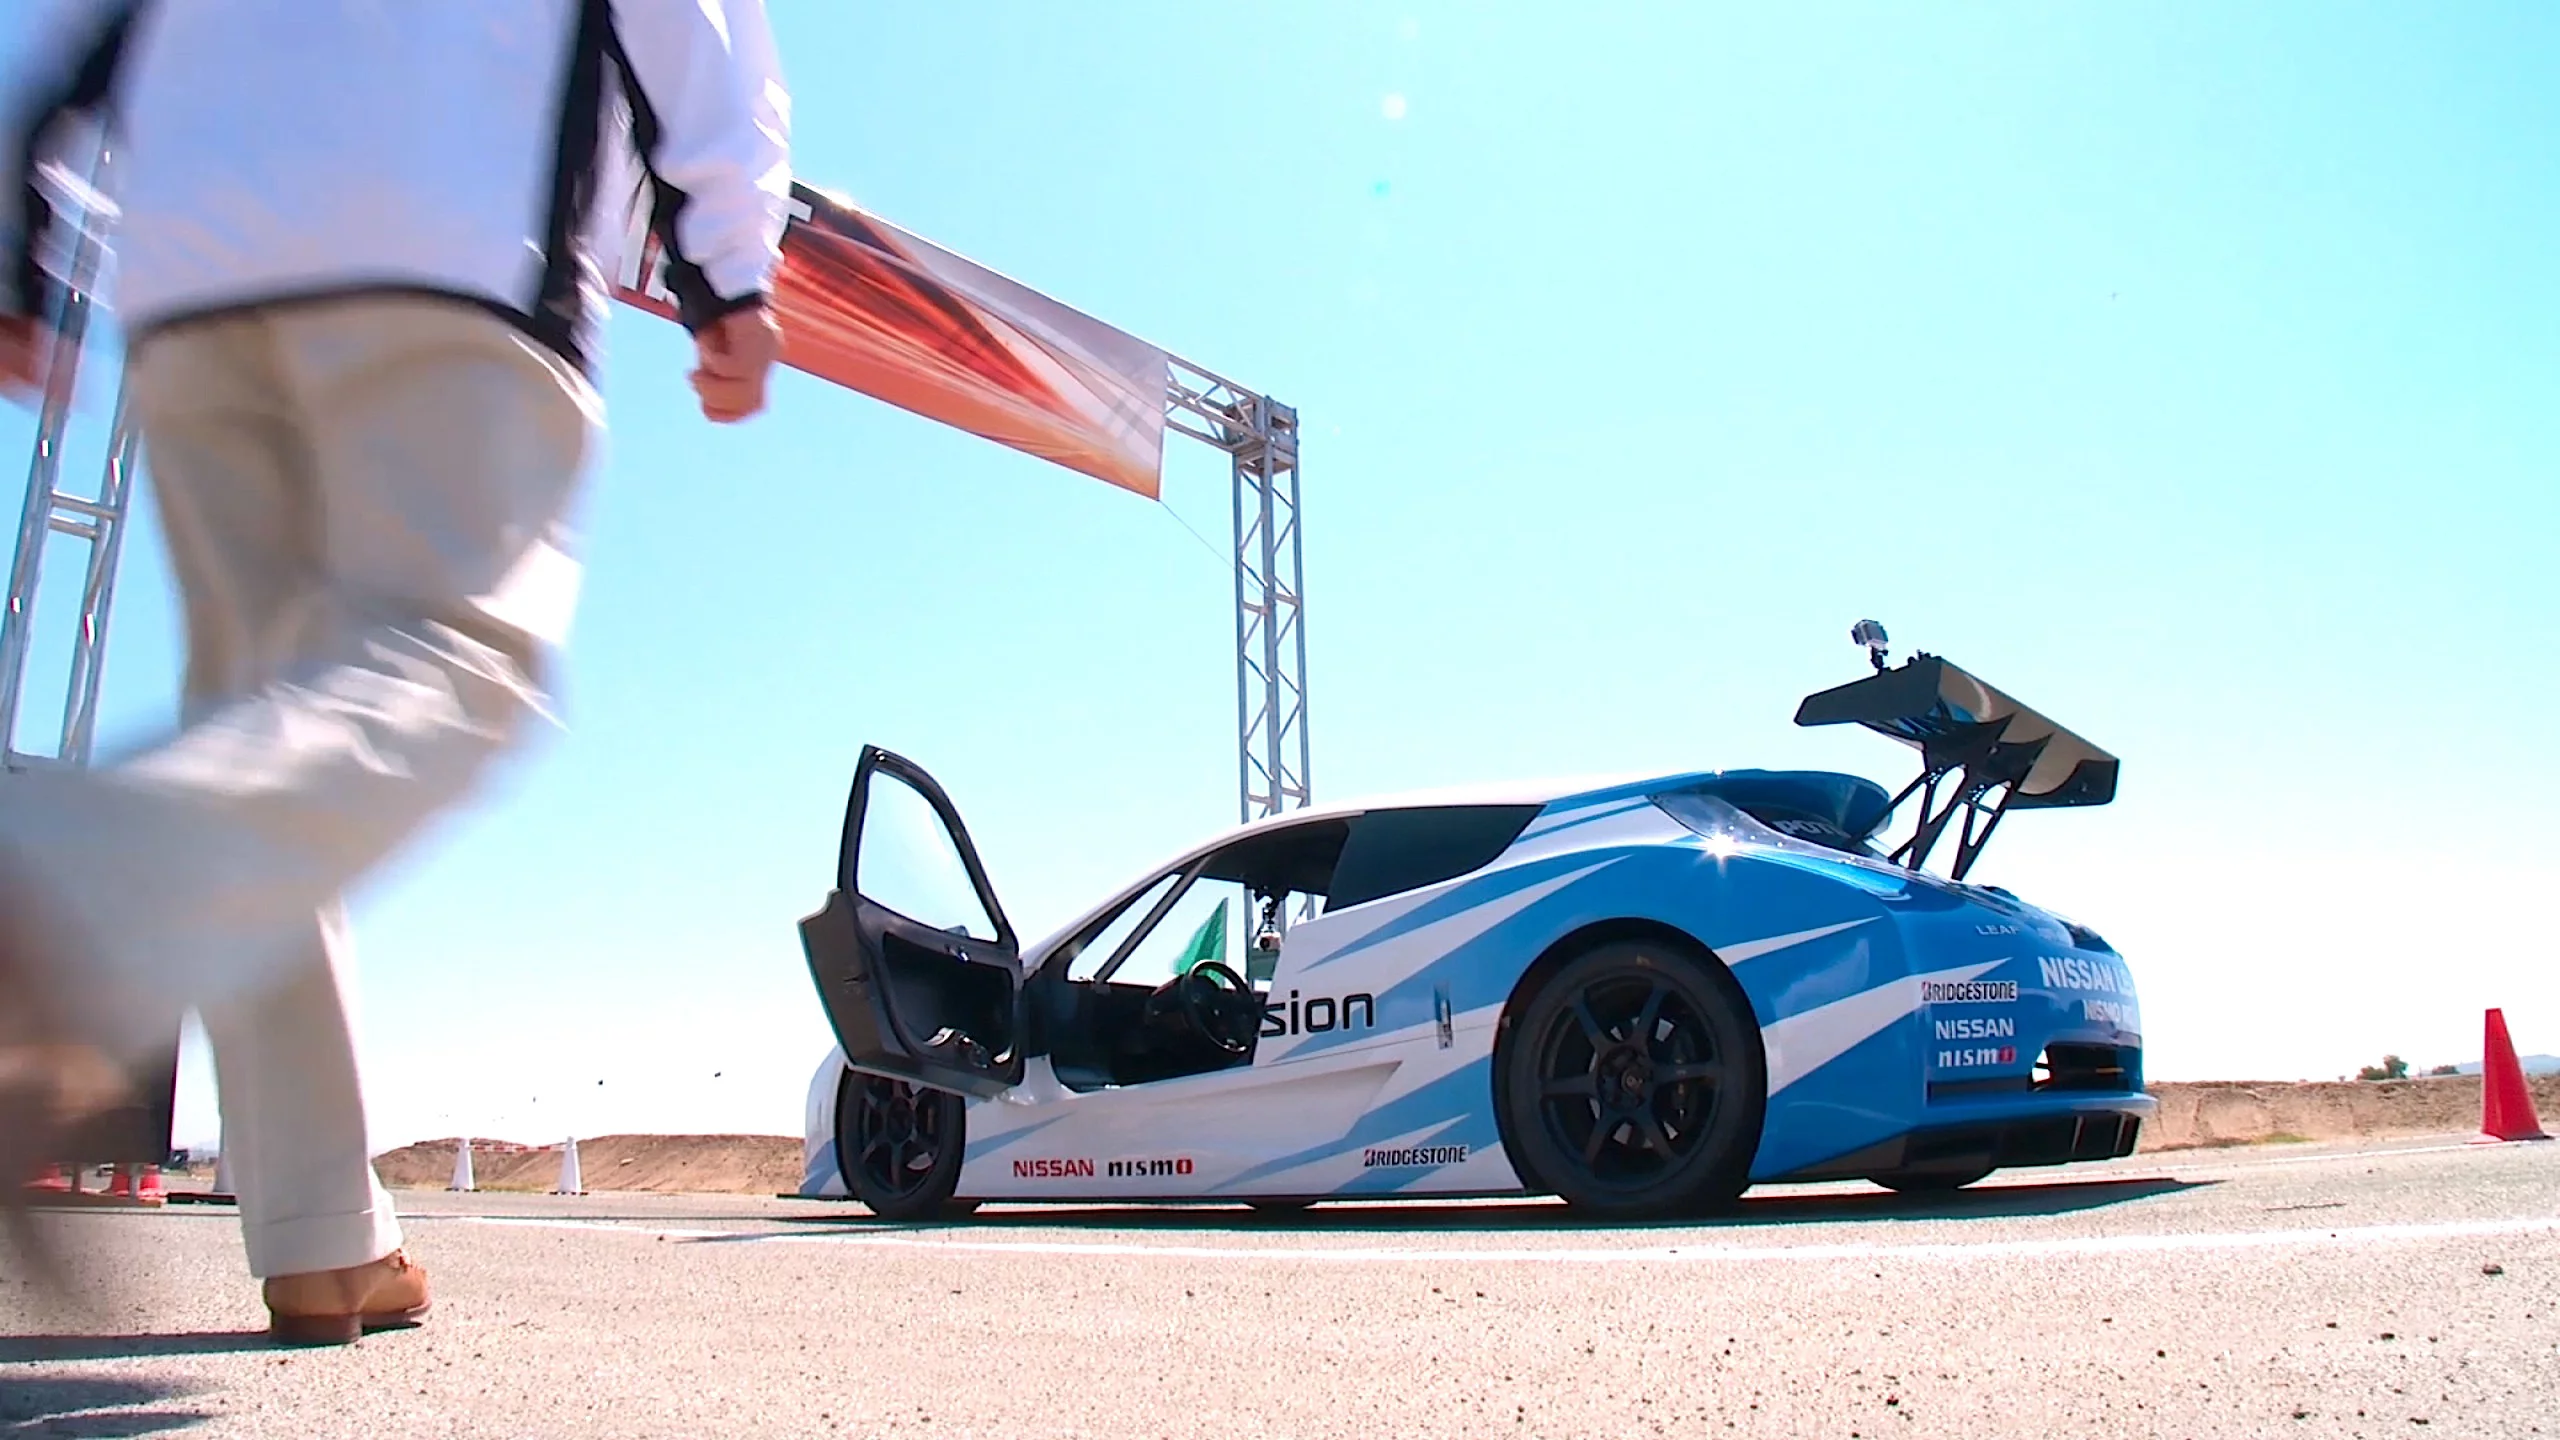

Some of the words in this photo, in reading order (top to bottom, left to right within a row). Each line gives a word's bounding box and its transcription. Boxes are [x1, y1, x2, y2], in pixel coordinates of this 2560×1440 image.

[1975, 924, 2020, 936] LEAF
[2037, 956, 2117, 993] NISSAN
[1921, 981, 2016, 1001] BRIDGESTONE
[1260, 990, 1374, 1038] sion
[1935, 1017, 2015, 1040] NISSAN
[1938, 1046, 2017, 1068] nismo
[1013, 1159, 1094, 1177] NISSAN
[1108, 1159, 1193, 1177] nismo
[1364, 1146, 1467, 1168] BRIDGESTONE
